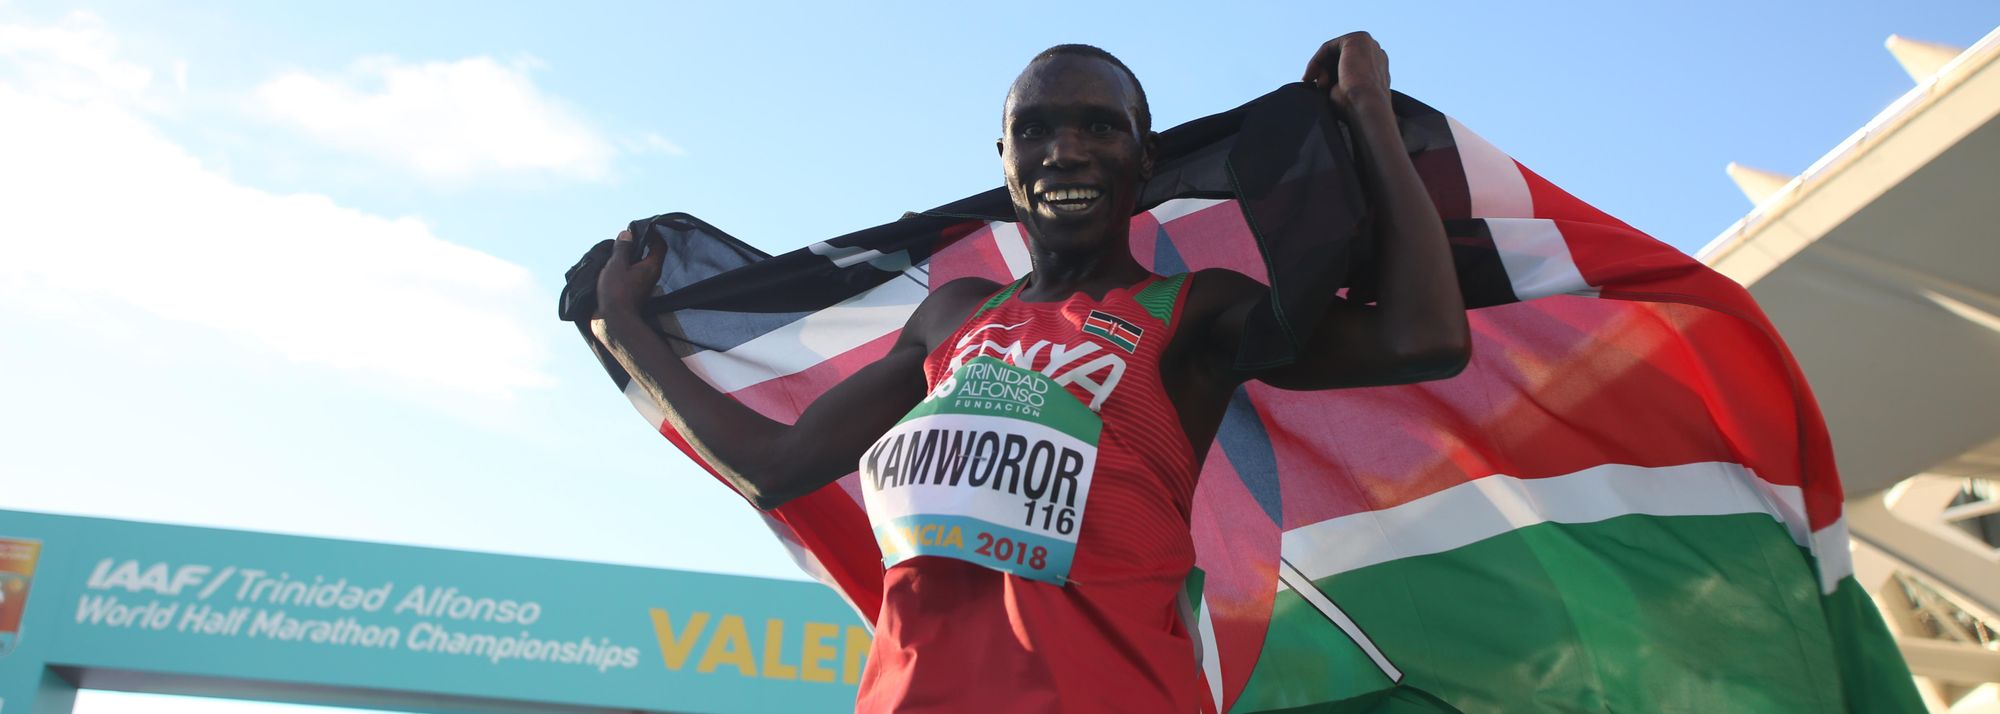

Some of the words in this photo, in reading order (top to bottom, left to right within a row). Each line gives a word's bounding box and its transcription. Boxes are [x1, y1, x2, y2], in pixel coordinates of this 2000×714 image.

[958, 380, 1045, 407] ALFONSO
[966, 362, 1049, 394] TRINIDAD
[955, 399, 1040, 418] FUNDACIÓN
[866, 429, 1084, 508] KAMWOROR
[1024, 500, 1076, 535] 116
[975, 531, 1048, 570] 2018
[87, 557, 211, 596] IAAF
[236, 568, 394, 613] Trinidad
[394, 584, 541, 626] Alfonso
[75, 594, 179, 631] World
[178, 602, 252, 637] Half
[246, 609, 402, 649] Marathon
[405, 621, 639, 672] Championships
